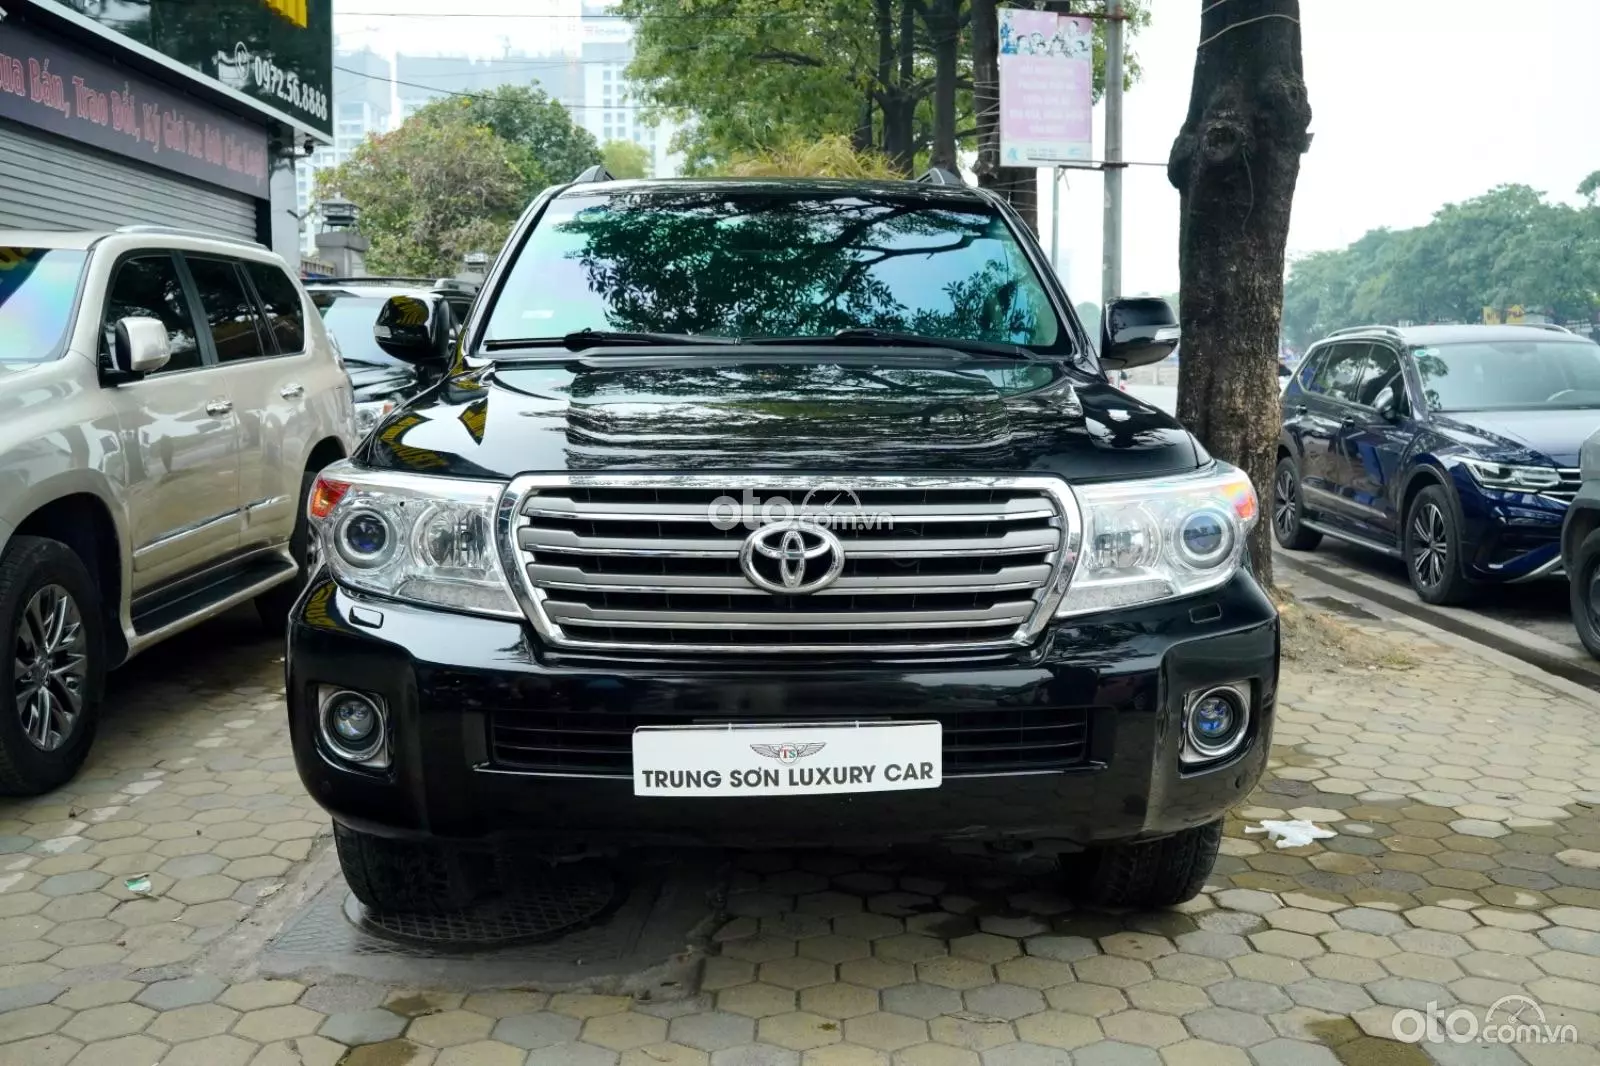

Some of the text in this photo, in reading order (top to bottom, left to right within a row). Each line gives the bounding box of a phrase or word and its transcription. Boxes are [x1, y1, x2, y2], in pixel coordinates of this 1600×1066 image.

[0, 52, 26, 97] ua
[29, 57, 71, 119] Bán,
[72, 75, 109, 127] Trao
[254, 55, 328, 121] 0972.56.8888
[642, 762, 934, 789] TRUNG SƠN LUXURY CAR
